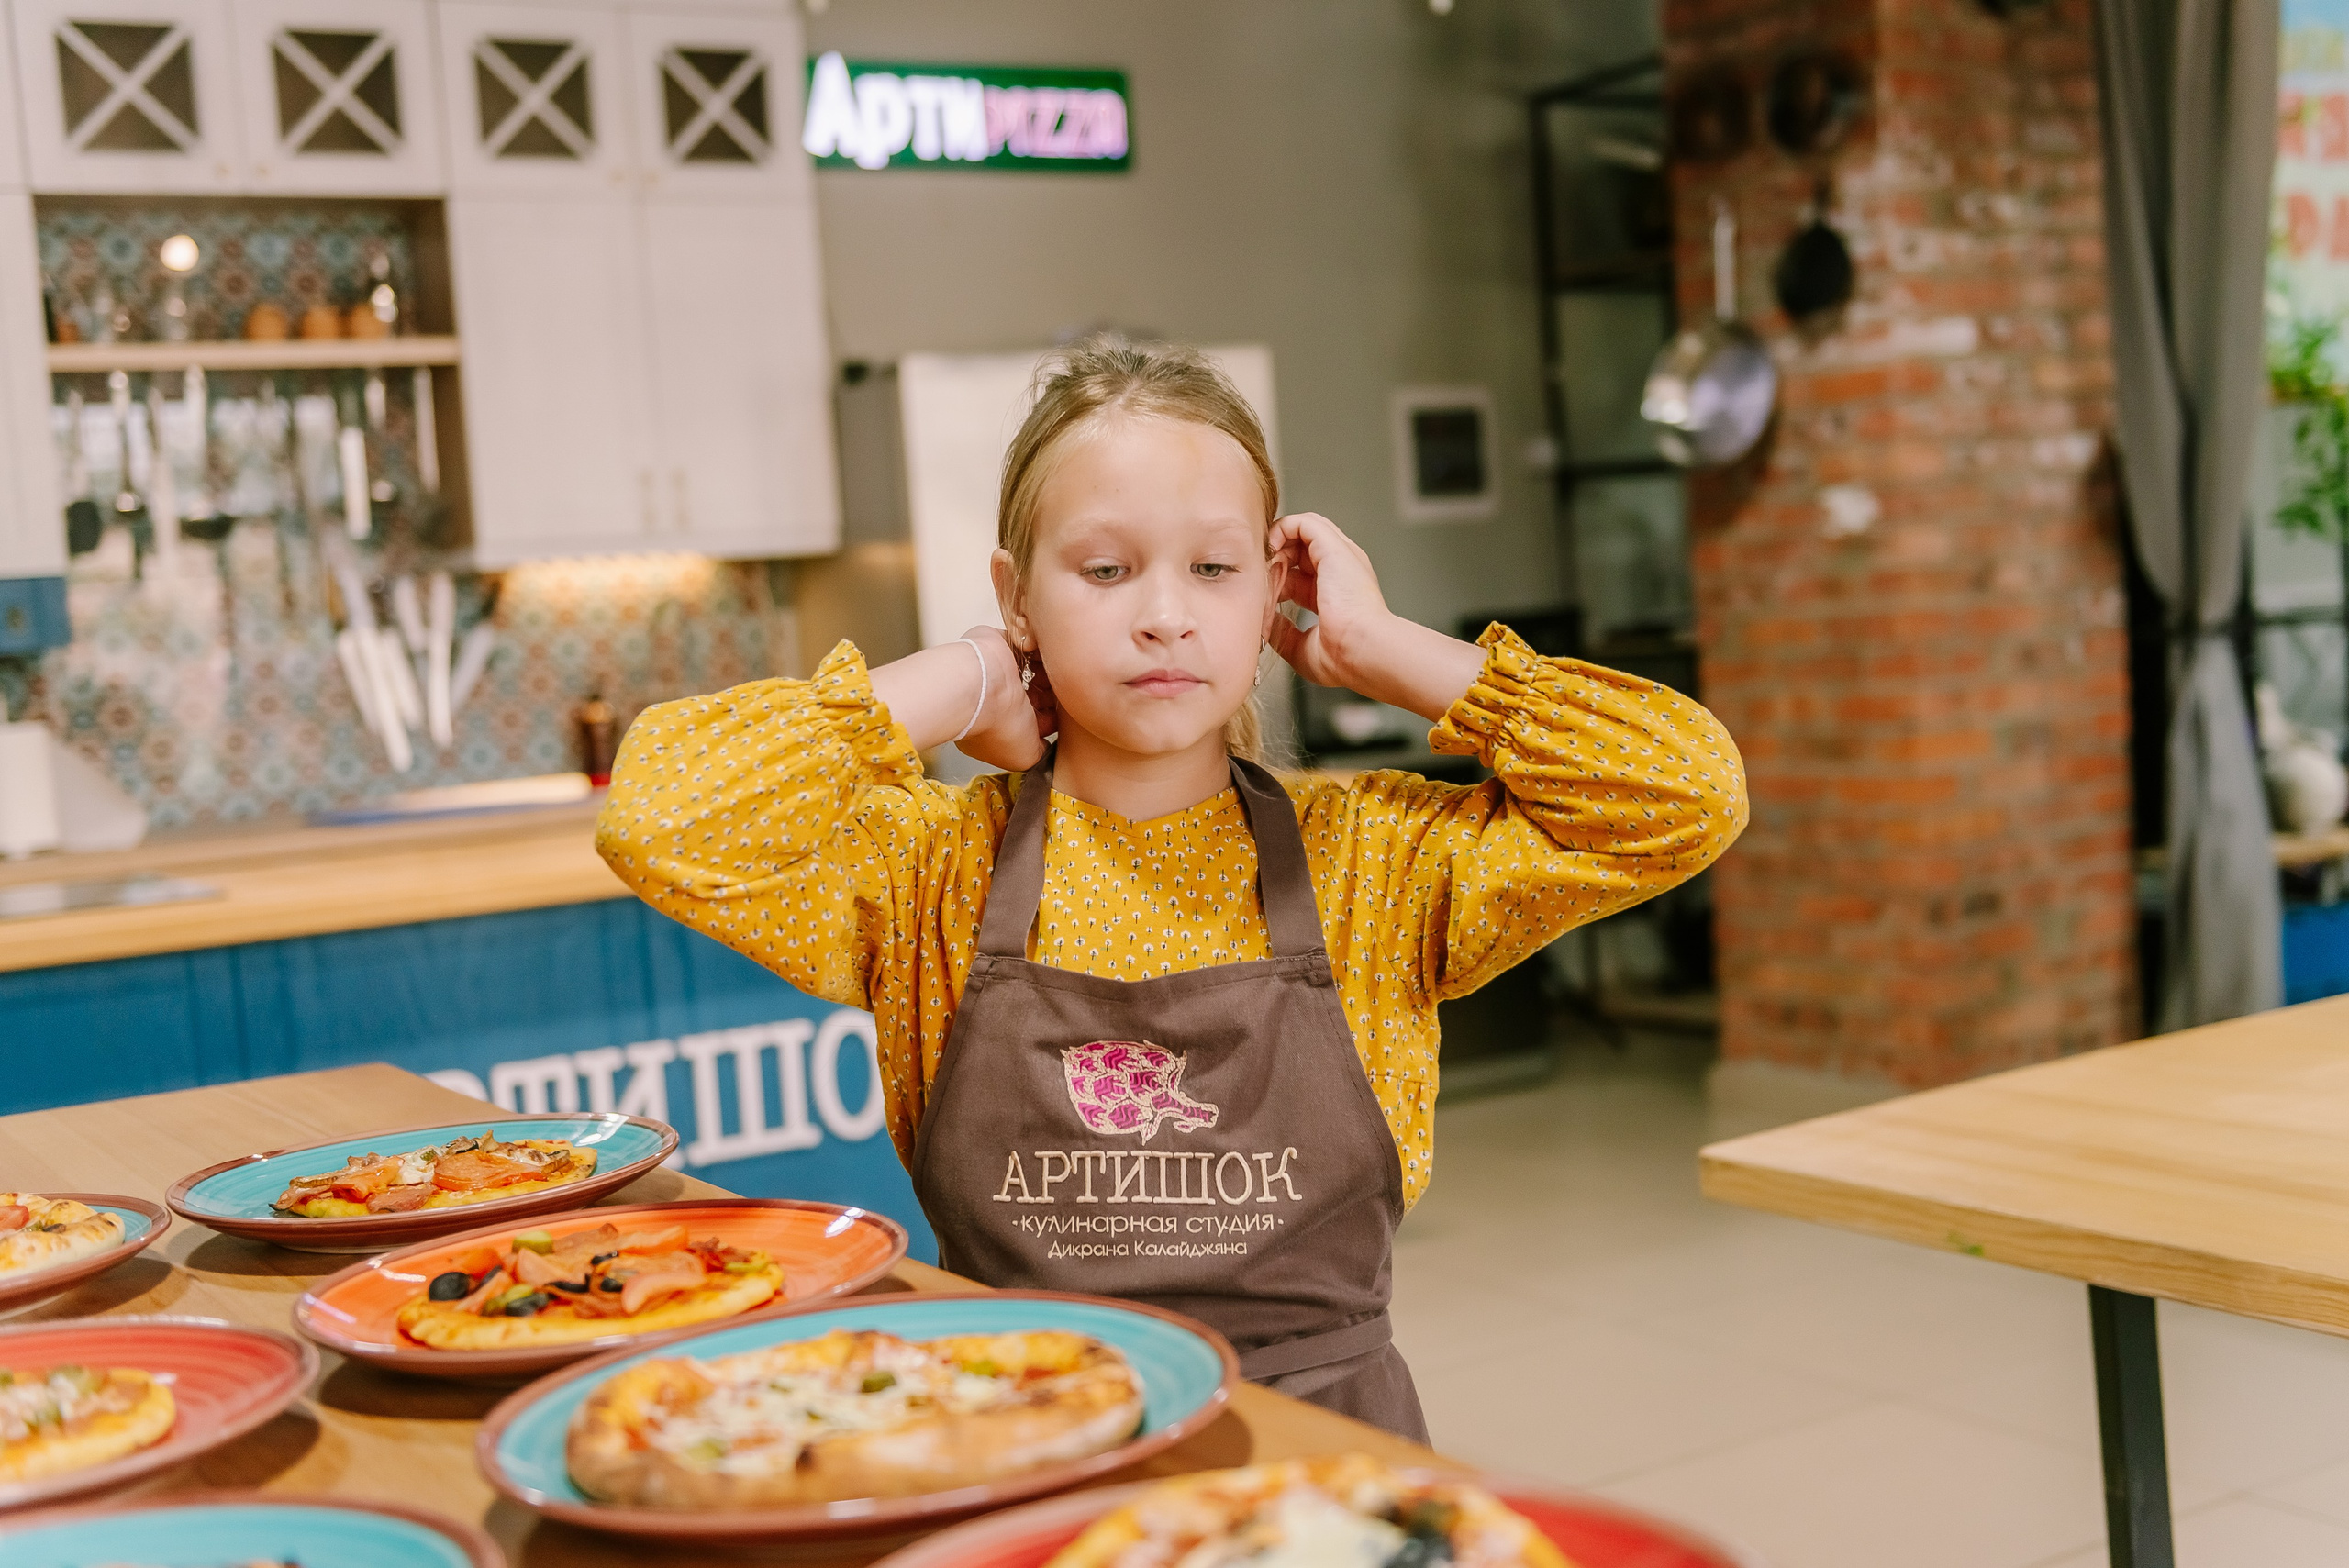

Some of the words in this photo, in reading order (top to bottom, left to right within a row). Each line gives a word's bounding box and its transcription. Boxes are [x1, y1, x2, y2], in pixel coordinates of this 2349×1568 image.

[993, 1147, 1302, 1205] АРТИШОК
[1047, 1240, 1130, 1259] Дикрана
[1134, 1240, 1248, 1259] Калайджяна
